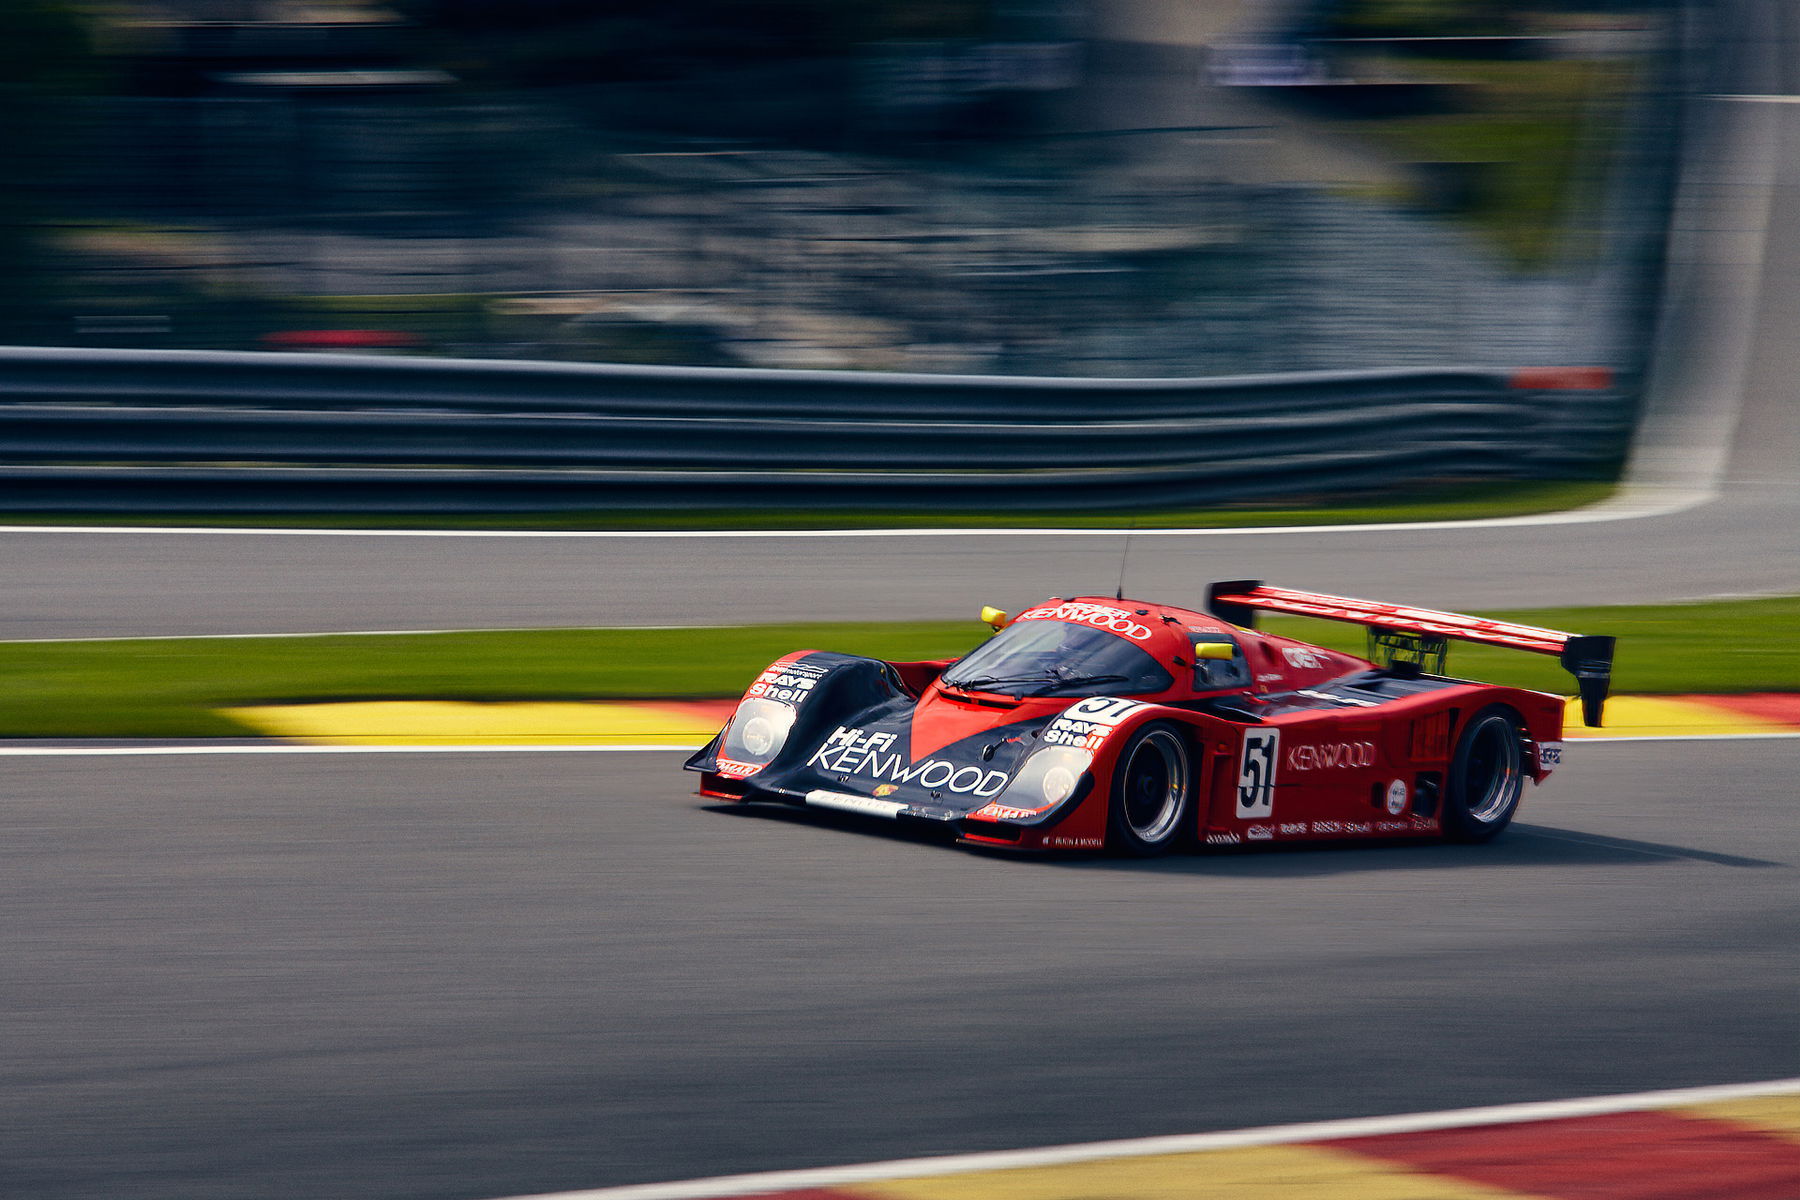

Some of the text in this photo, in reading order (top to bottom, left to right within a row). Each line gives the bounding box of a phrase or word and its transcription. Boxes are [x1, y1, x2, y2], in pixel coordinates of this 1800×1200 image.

[1015, 607, 1153, 641] KENWOOD
[749, 683, 809, 703] Shell
[757, 671, 818, 690] RAYS
[826, 726, 898, 753] Hi-Fi
[1043, 729, 1105, 750] Shell
[1052, 718, 1113, 737] RAYS
[1286, 741, 1376, 771] KENWOOD
[807, 742, 1010, 798] KENWOOD
[1240, 735, 1276, 808] 51
